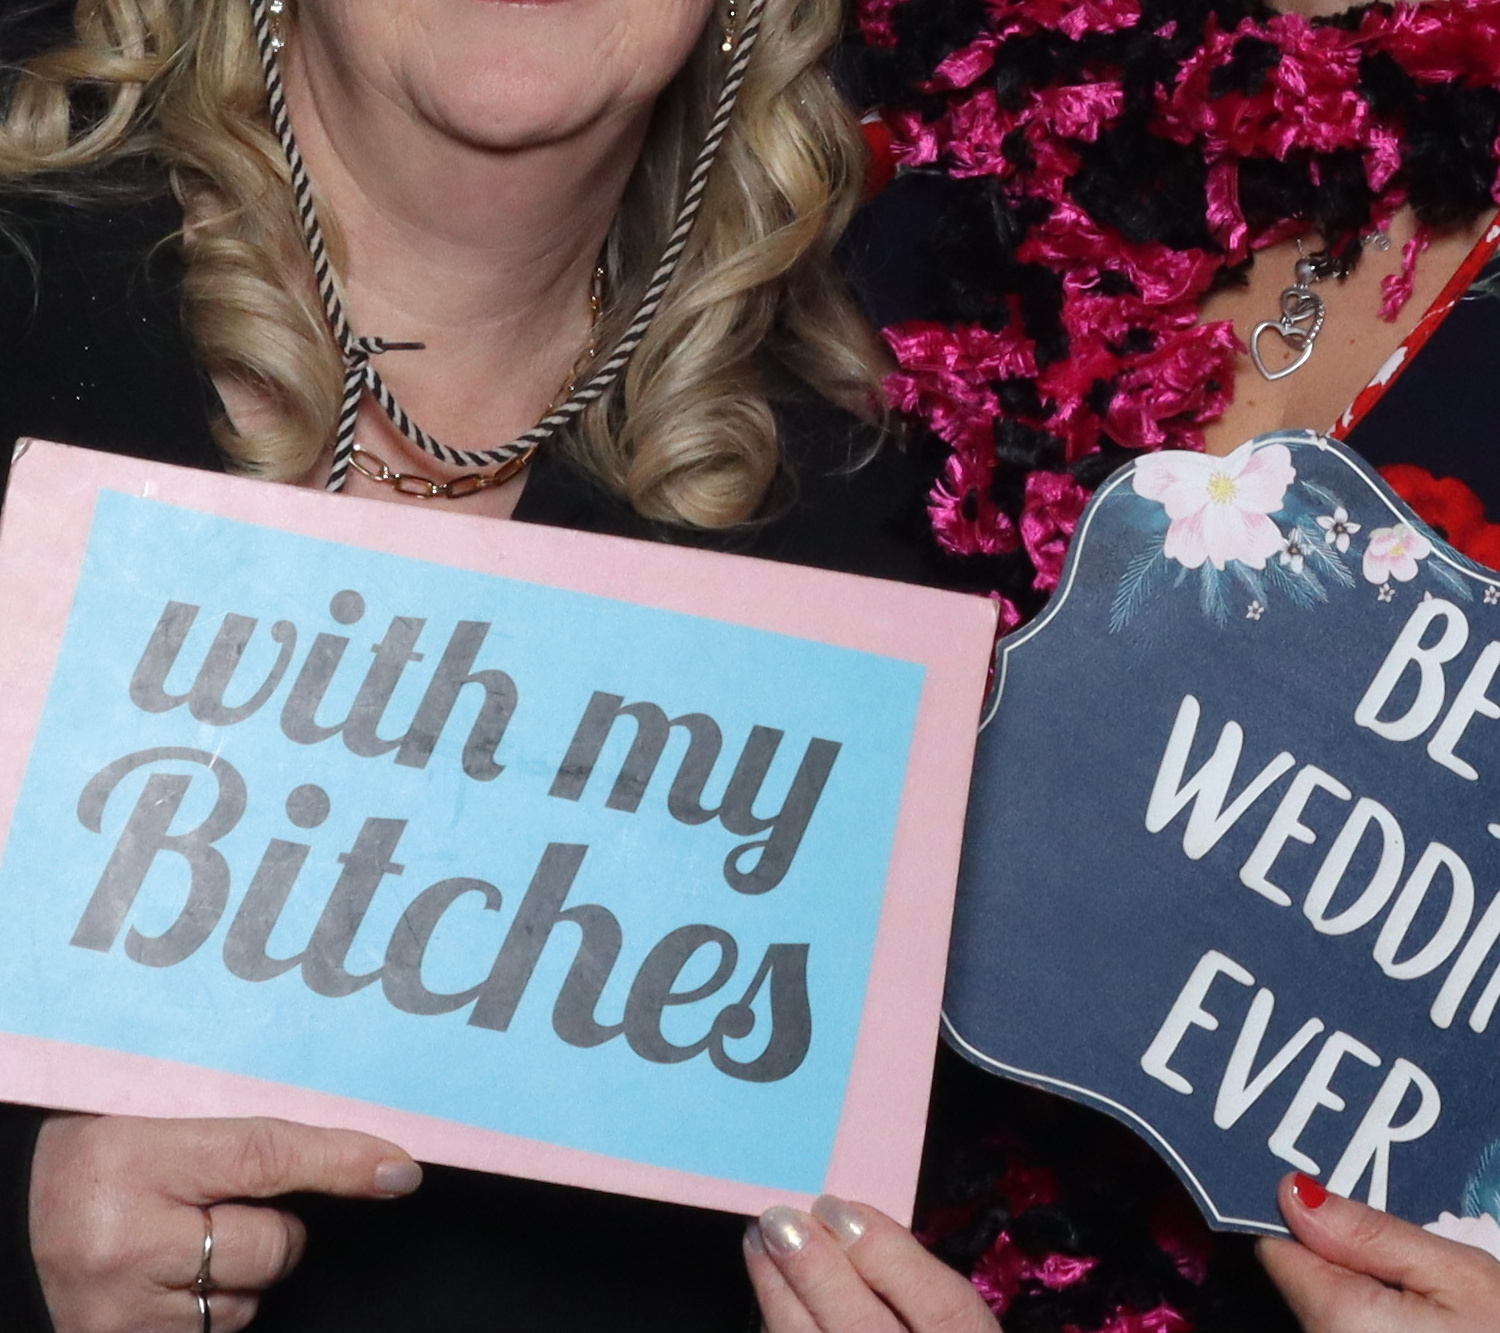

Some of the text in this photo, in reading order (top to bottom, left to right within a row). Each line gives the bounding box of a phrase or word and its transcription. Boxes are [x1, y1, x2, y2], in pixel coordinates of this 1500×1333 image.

[126, 587, 845, 897] with my
[66, 743, 814, 1085] Bitches
[1140, 948, 1442, 1212] EVER
